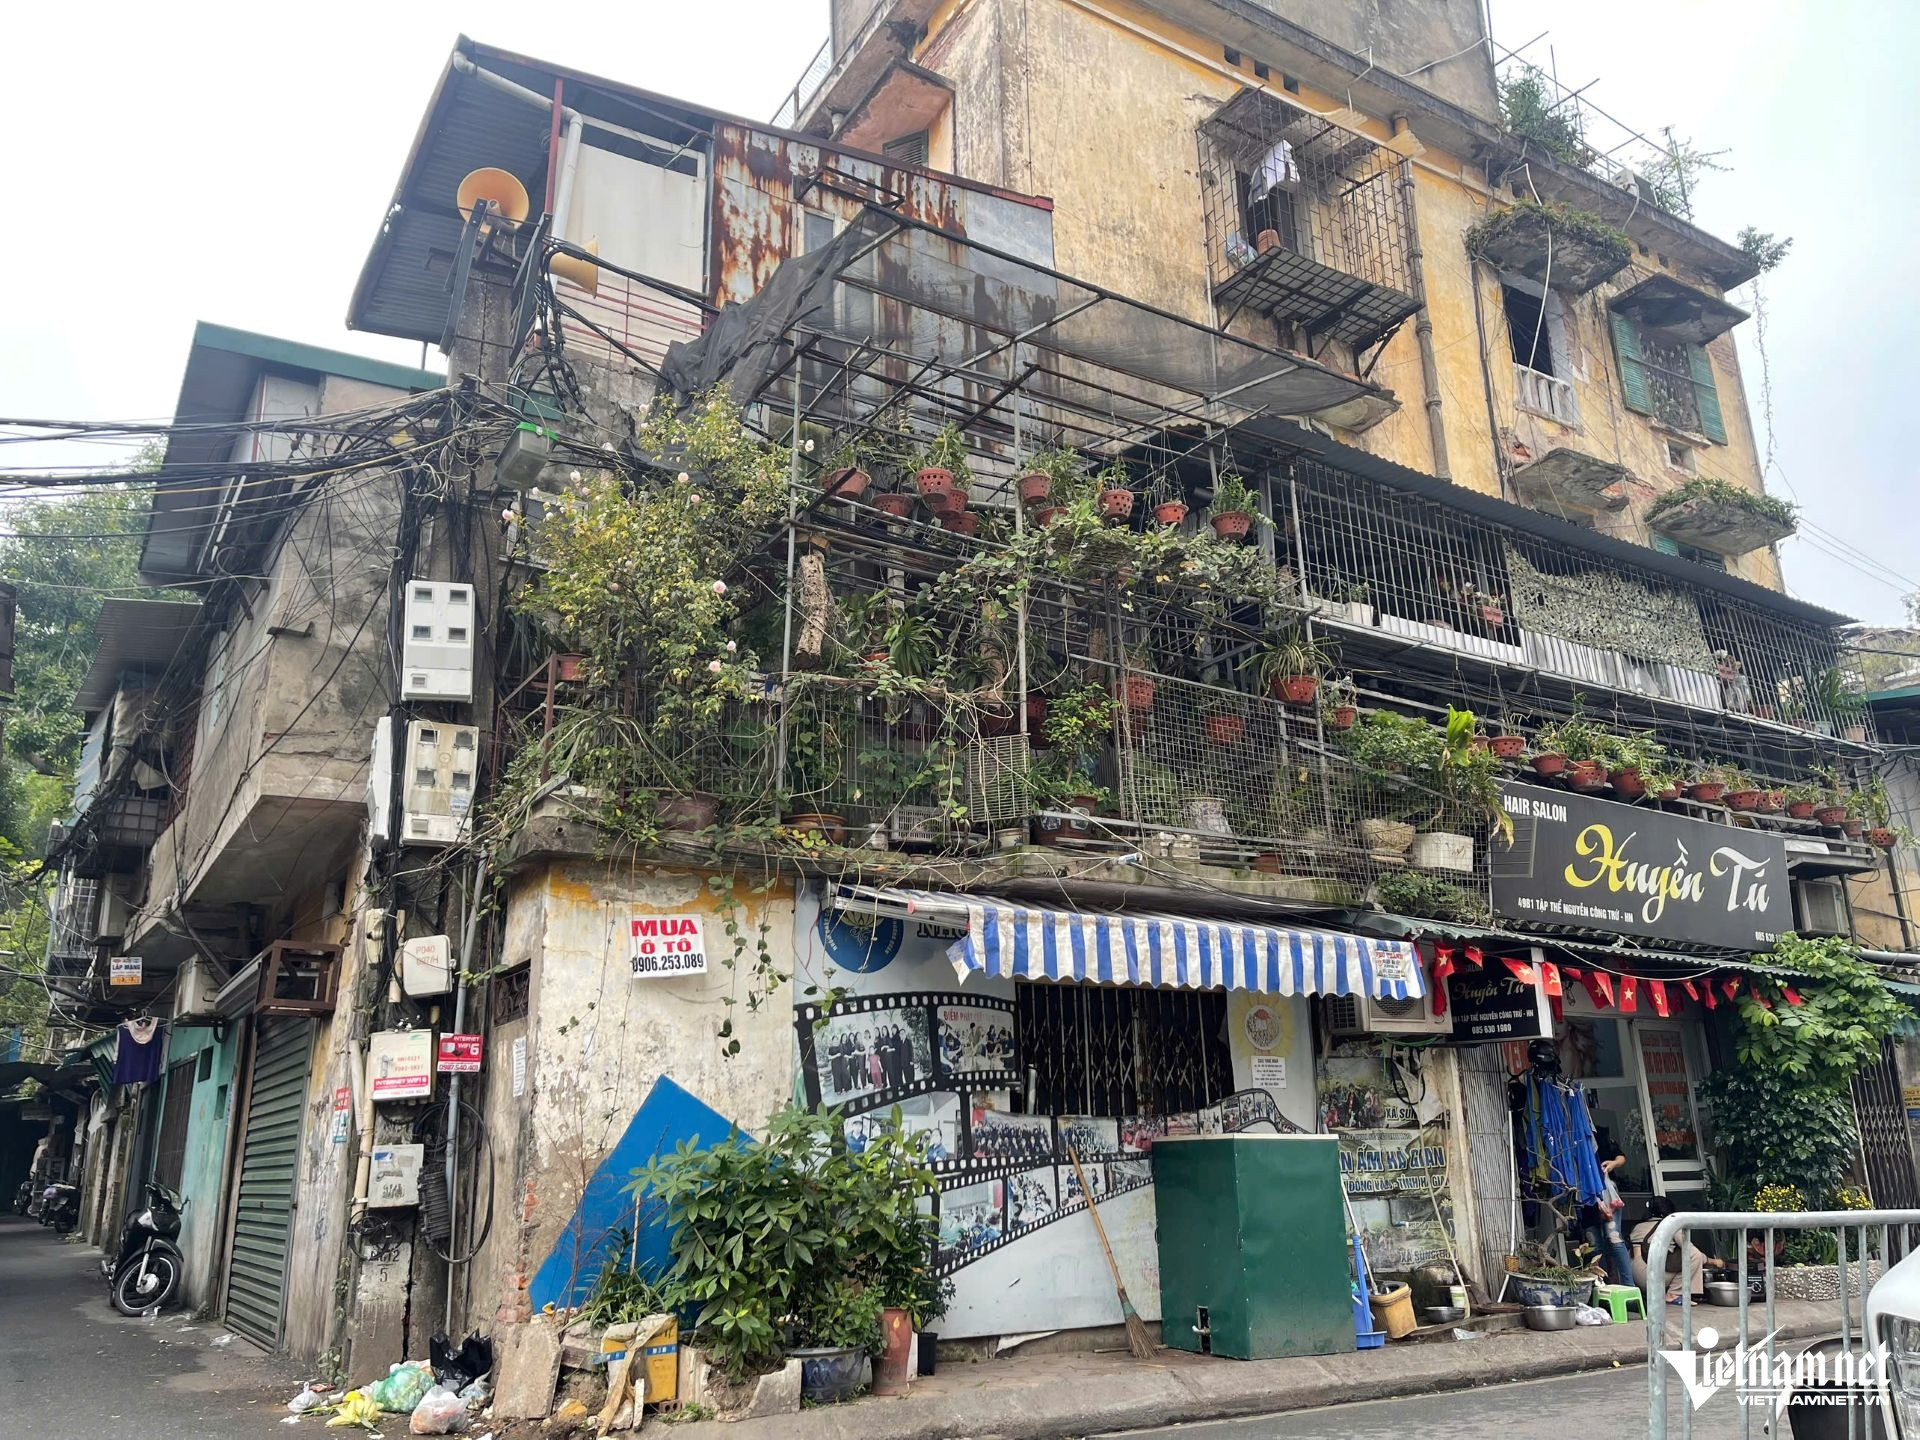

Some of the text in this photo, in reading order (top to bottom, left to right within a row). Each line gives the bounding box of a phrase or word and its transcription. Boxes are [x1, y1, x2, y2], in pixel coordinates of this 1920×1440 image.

[1504, 795, 1567, 822] HAIR SALON
[1564, 823, 1771, 924] Huyền Tú
[1517, 897, 1534, 910] 49B1
[1535, 898, 1549, 913] TẬP
[1562, 902, 1589, 917] NGUYỄN
[1589, 905, 1607, 919] CÔNG
[1624, 912, 1634, 923] HN
[631, 919, 698, 937] MUA
[640, 938, 692, 955] Ô TÔ
[632, 953, 704, 973] 0906.253.089
[1452, 980, 1498, 1005] Huyền
[1498, 1010, 1513, 1019] CÔNG
[1526, 1009, 1534, 1017] HN
[1471, 1025, 1483, 1035] 085
[1483, 1024, 1496, 1034] 630
[470, 1043, 480, 1056] 6
[1386, 1147, 1408, 1169] HÀ
[379, 1267, 389, 1282] 5
